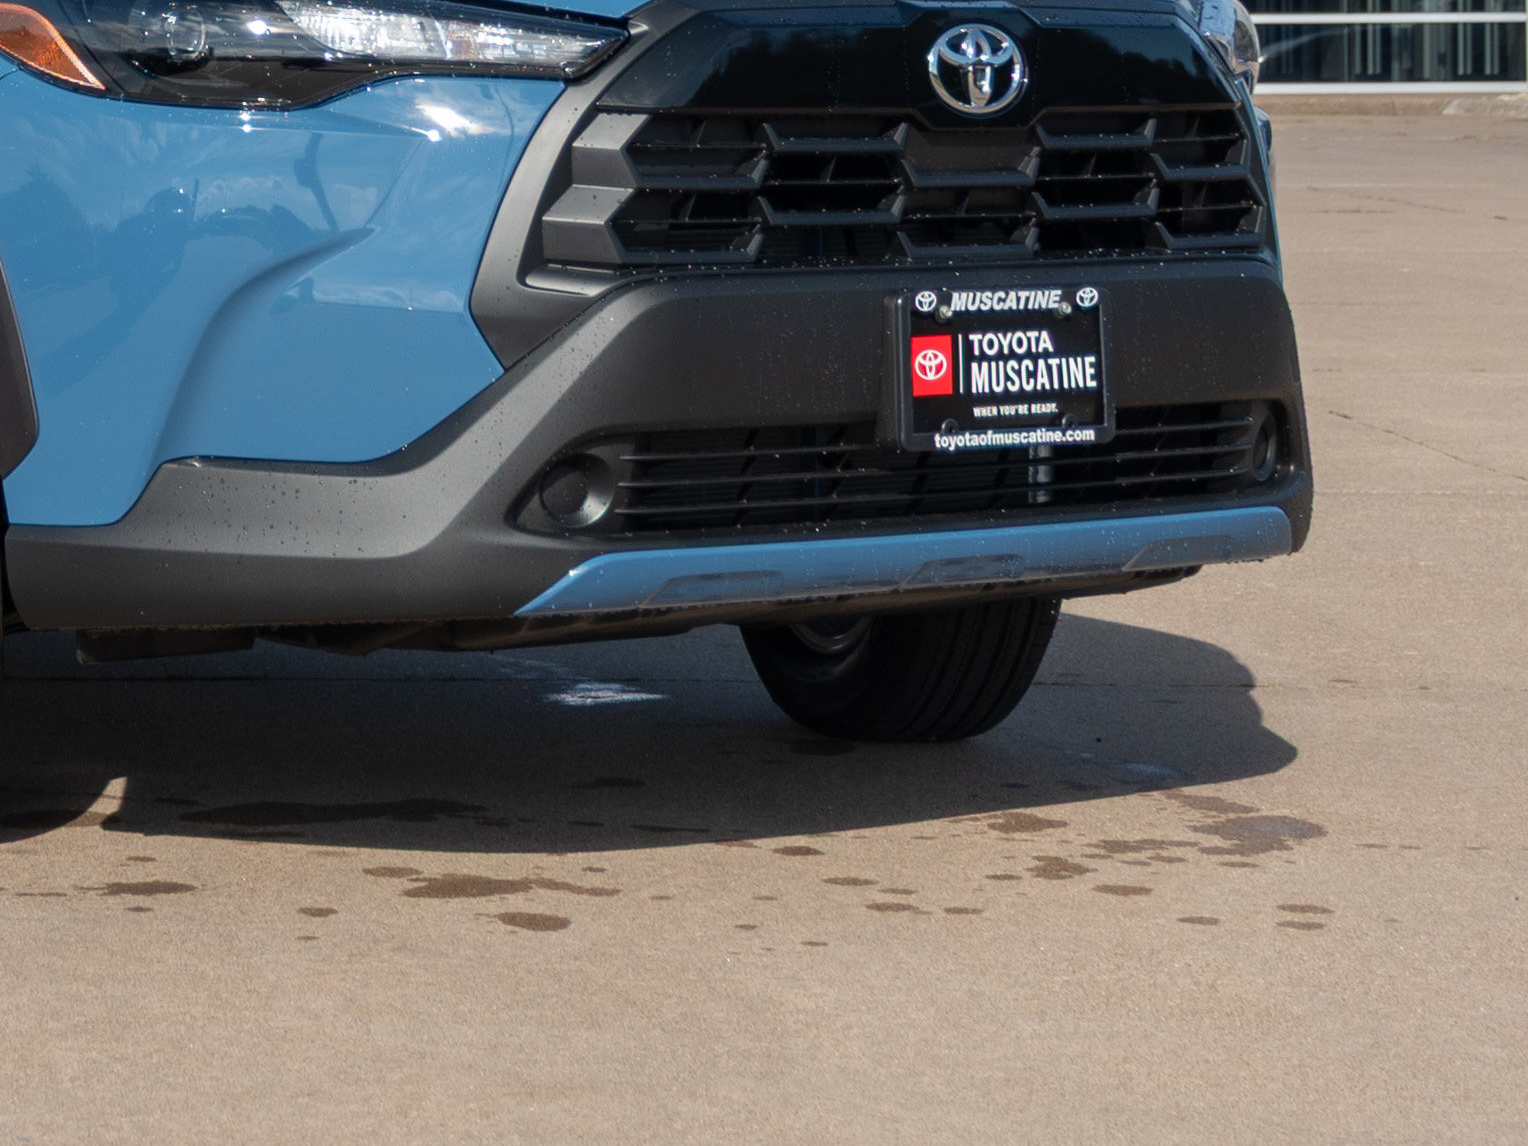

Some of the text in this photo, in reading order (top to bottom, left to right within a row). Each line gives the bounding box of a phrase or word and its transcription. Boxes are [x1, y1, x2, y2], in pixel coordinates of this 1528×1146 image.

[950, 290, 1062, 311] MUSCATINE
[969, 331, 1054, 355] TOYOTA
[971, 356, 1097, 394] MUSCATINE
[973, 403, 1059, 417] WHEN YOU'RE READY.
[934, 428, 1095, 451] toyotaofmuscatine.com
